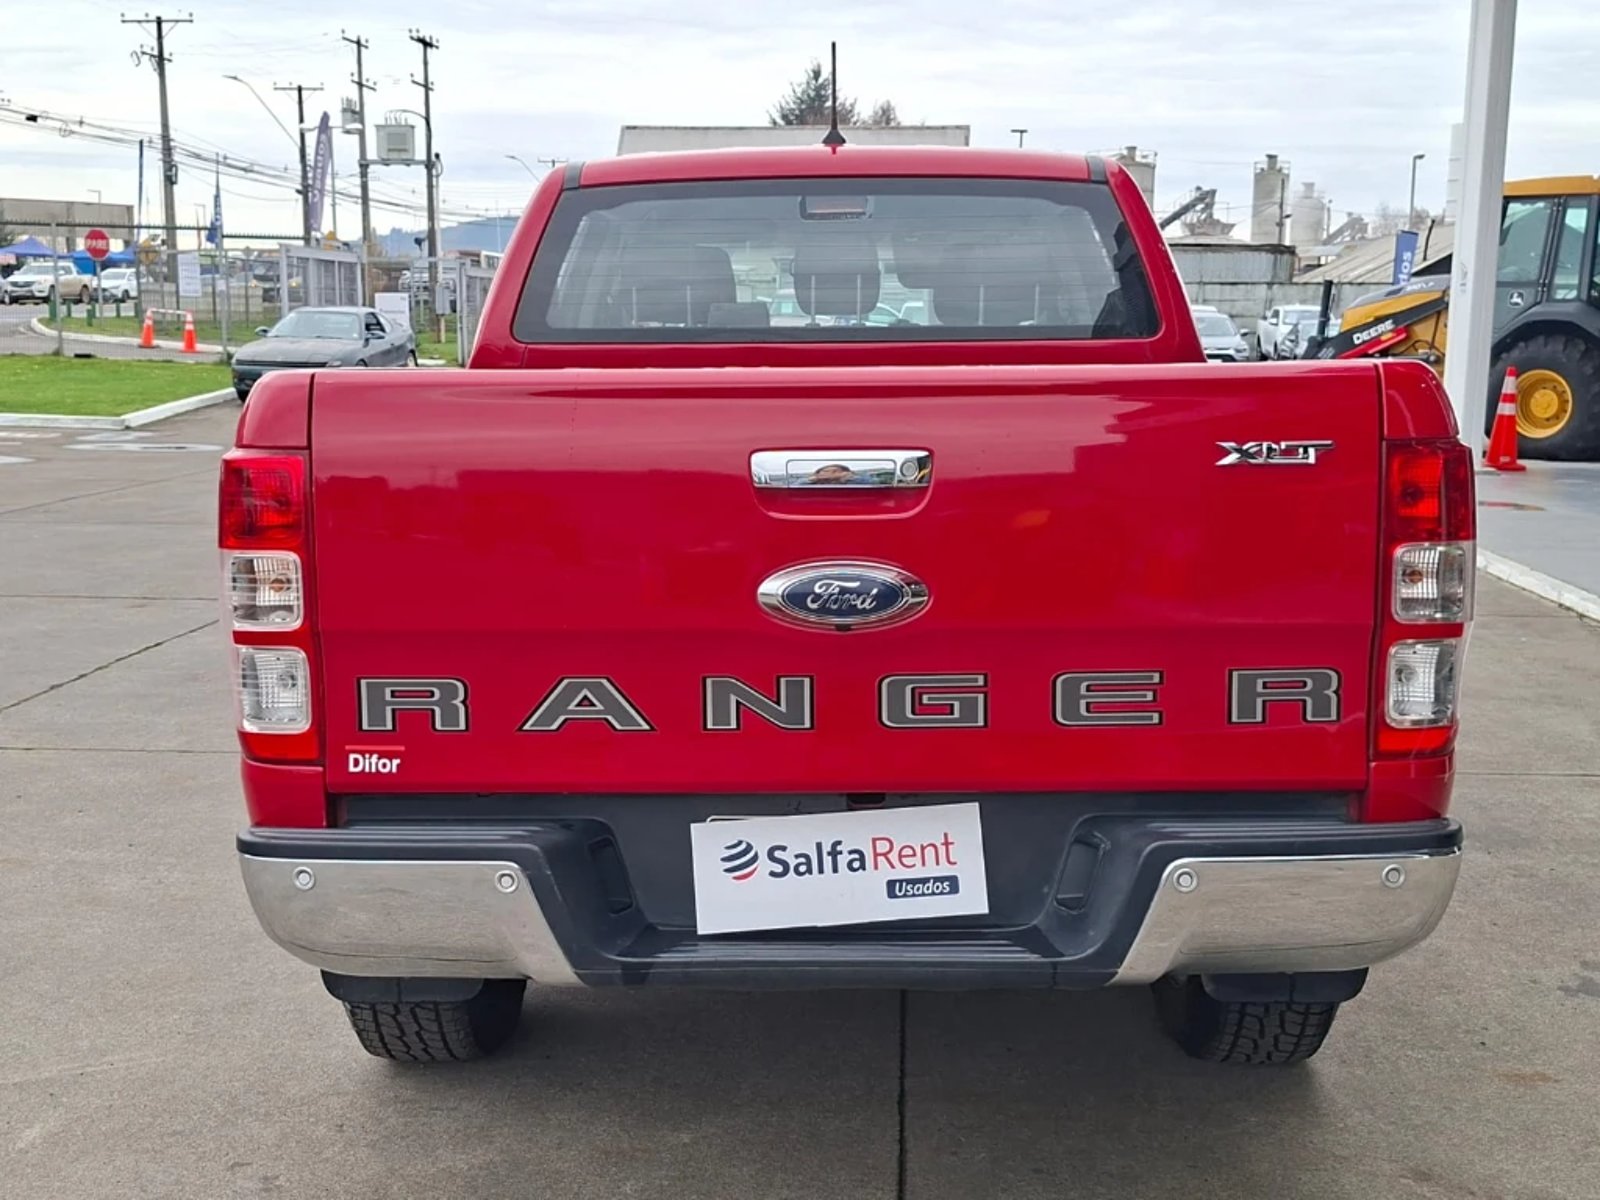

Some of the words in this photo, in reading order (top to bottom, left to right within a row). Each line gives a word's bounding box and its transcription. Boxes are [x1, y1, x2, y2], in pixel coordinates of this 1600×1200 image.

[86, 238, 109, 250] PARE
[1398, 251, 1412, 285] dos
[1352, 319, 1396, 344] DEERE
[1215, 440, 1334, 466] XLT
[806, 579, 878, 610] Ford
[356, 667, 1342, 734] RANGER
[348, 753, 401, 773] Difor
[766, 832, 958, 879] SalfaRent
[894, 879, 951, 897] Usados
